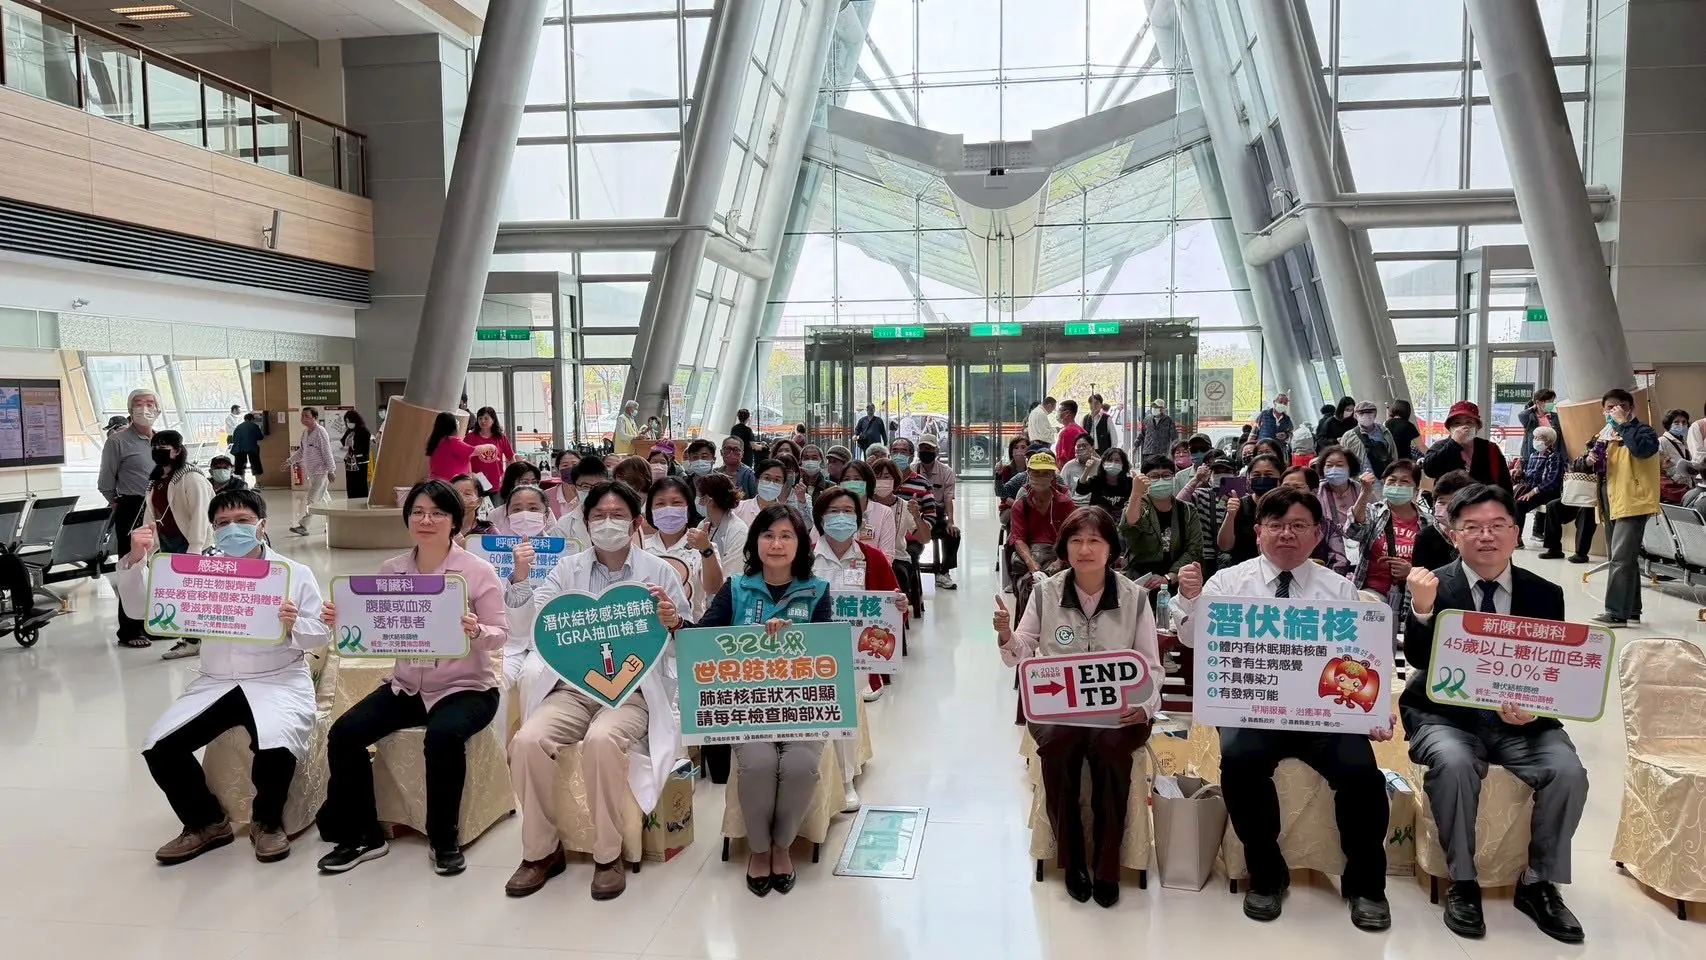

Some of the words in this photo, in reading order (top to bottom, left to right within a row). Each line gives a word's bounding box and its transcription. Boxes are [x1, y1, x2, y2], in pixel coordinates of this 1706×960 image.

[198, 560, 238, 574] 感染科
[182, 577, 257, 592] 使用生物製劑者
[375, 579, 414, 592] 腎臟科
[180, 602, 255, 617] 愛滋病毒感染者
[366, 599, 433, 613] 腹膜或血液
[543, 599, 655, 632] 潛伏結核感染篩檢
[373, 615, 426, 629] 透析患者
[556, 619, 650, 646] IGRA抽血檢查
[1207, 602, 1359, 642] 潛伏結核
[1482, 618, 1567, 641] 新陳代謝科
[716, 632, 781, 656] 324
[1219, 641, 1328, 657] 體內有休眠期結核菌
[1443, 637, 1603, 670] 45歲以上糖化血色素
[693, 655, 838, 683] 世界結核病日
[1078, 661, 1138, 684] END
[1219, 656, 1304, 672] 不會有生病感覺
[1219, 671, 1279, 686] 不具傳染力
[699, 685, 836, 706] 肺結核症狀不明顯
[1080, 686, 1118, 707] TB
[1219, 687, 1279, 701] 有發病可能
[696, 705, 841, 727] 請每年檢查胸部X光
